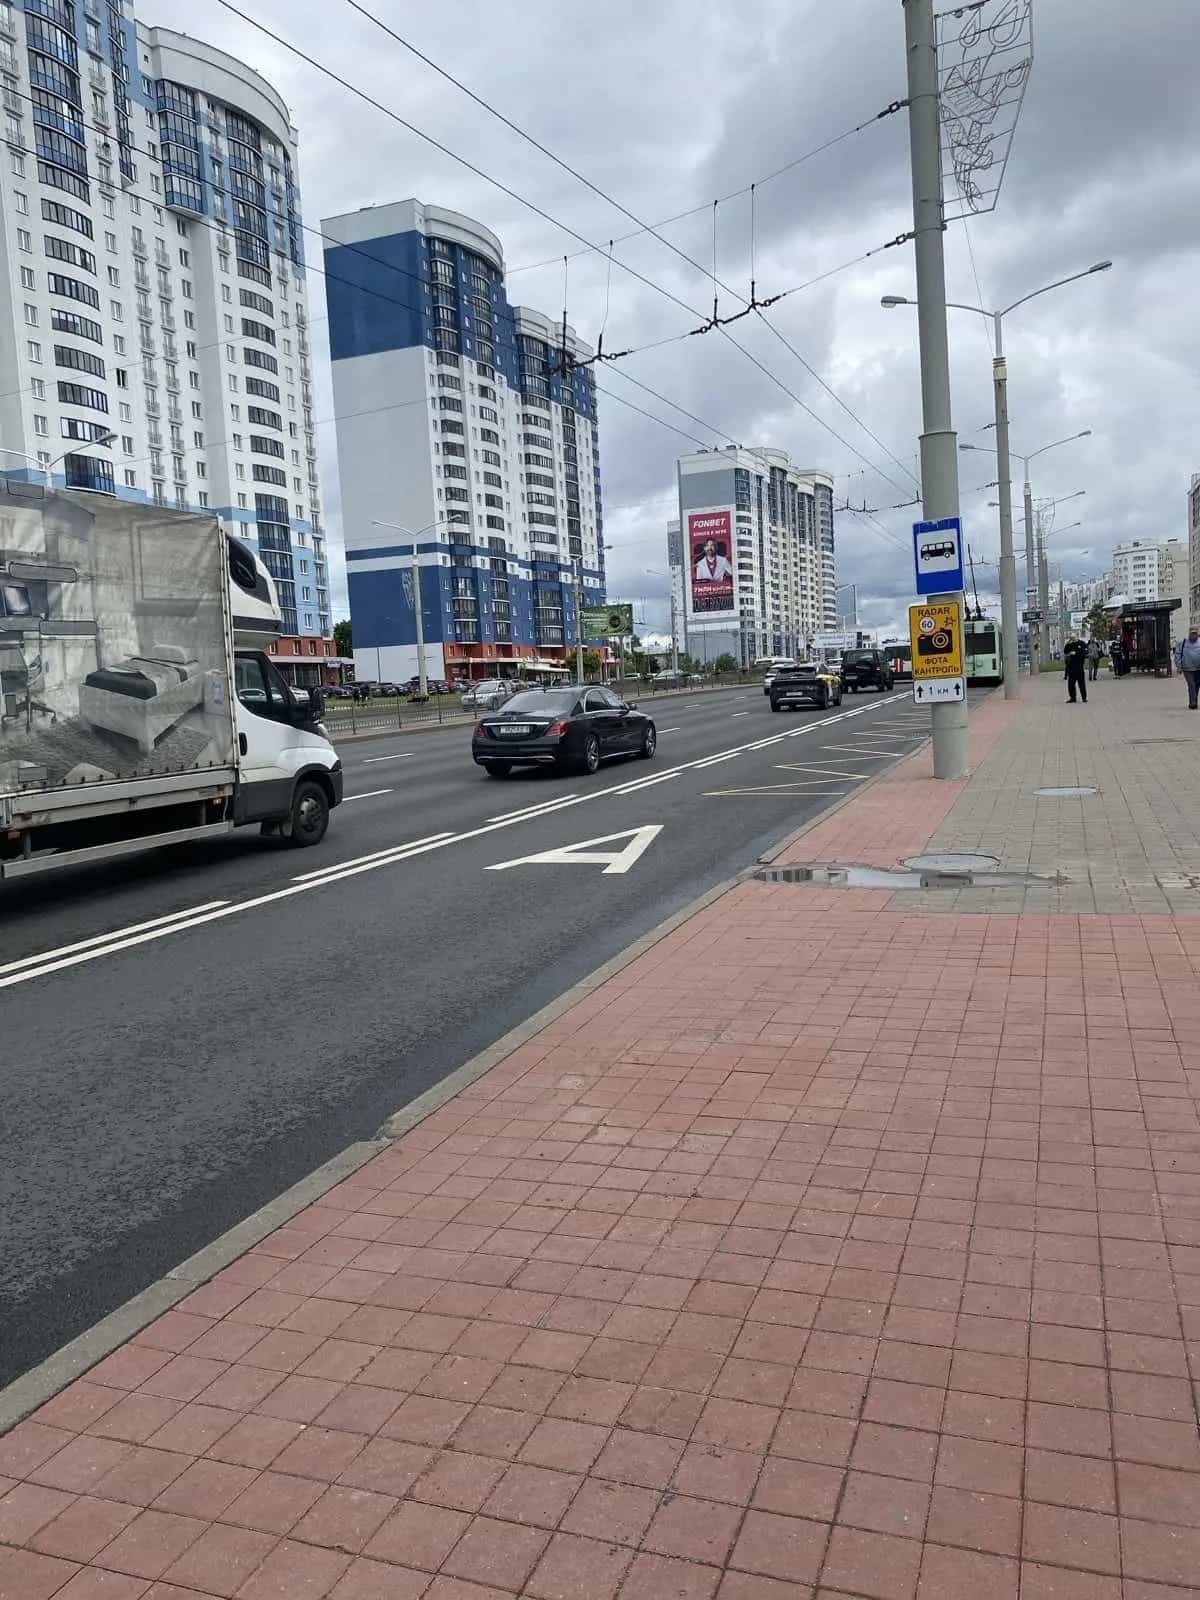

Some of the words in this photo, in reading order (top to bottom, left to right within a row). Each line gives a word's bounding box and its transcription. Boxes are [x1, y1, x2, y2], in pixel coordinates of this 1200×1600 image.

[693, 518, 726, 529] FONBET
[917, 606, 950, 617] RADAR
[924, 656, 948, 665] ФОТА
[914, 665, 960, 676] КАНТРОЛЬ
